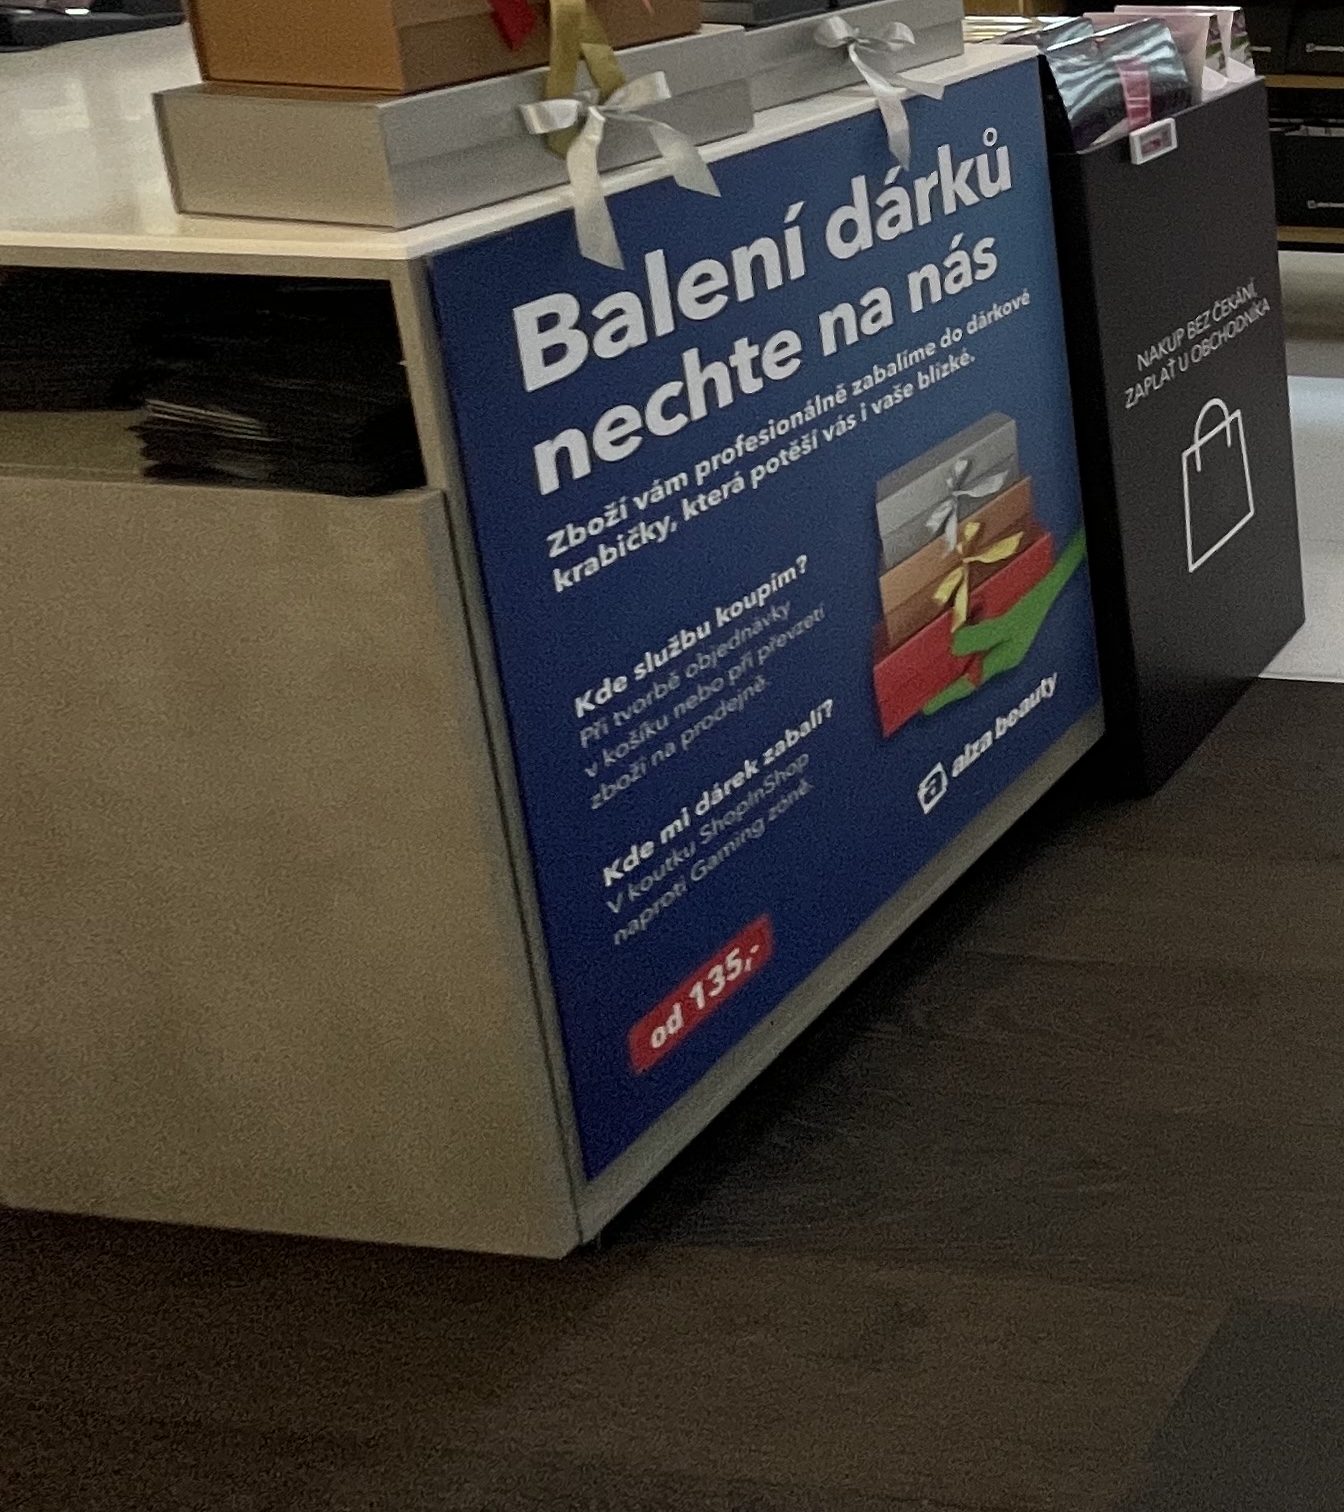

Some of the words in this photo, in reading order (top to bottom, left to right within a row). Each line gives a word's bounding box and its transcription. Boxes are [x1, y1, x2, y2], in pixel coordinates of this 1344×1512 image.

[512, 201, 806, 393] Balení
[824, 127, 1013, 260] dárků
[533, 328, 803, 496] nechte
[818, 286, 894, 357] na
[907, 232, 999, 314] nás
[1124, 356, 1178, 410] ZAPLAŤ
[1178, 350, 1190, 372] U
[1190, 297, 1271, 364] OBCHODNÍKA
[1137, 326, 1186, 372] NAKUP
[1187, 310, 1212, 342] BEZ
[546, 501, 629, 558] Zboží
[633, 471, 688, 511] vám
[694, 386, 848, 486] profesionálně
[852, 341, 937, 397] zabalíme
[939, 325, 964, 350] do
[966, 288, 1031, 338] dárkové
[553, 514, 679, 593] krabičky,
[681, 469, 746, 522] která
[750, 428, 819, 492] potěší
[822, 413, 858, 444] vás
[860, 404, 869, 423] i
[872, 382, 913, 416] vaše
[917, 350, 976, 391] blízké.
[574, 674, 629, 719] Kde
[633, 621, 711, 681] službu
[714, 554, 809, 627] koupím?
[579, 712, 609, 748] Při
[612, 676, 682, 727] tvorbě
[684, 599, 792, 688] objednávky
[590, 759, 649, 810] zboží
[650, 741, 677, 769] na
[601, 710, 670, 768] košíku
[672, 676, 726, 718] nebo
[950, 728, 992, 777] alza
[993, 672, 1059, 741] beauty
[602, 840, 655, 887] Kde
[659, 807, 692, 845] mi
[695, 758, 760, 816] dárek
[762, 698, 834, 766] zabalí?
[690, 816, 767, 882] Gaming
[628, 841, 697, 902] koutku
[649, 1003, 684, 1049] od
